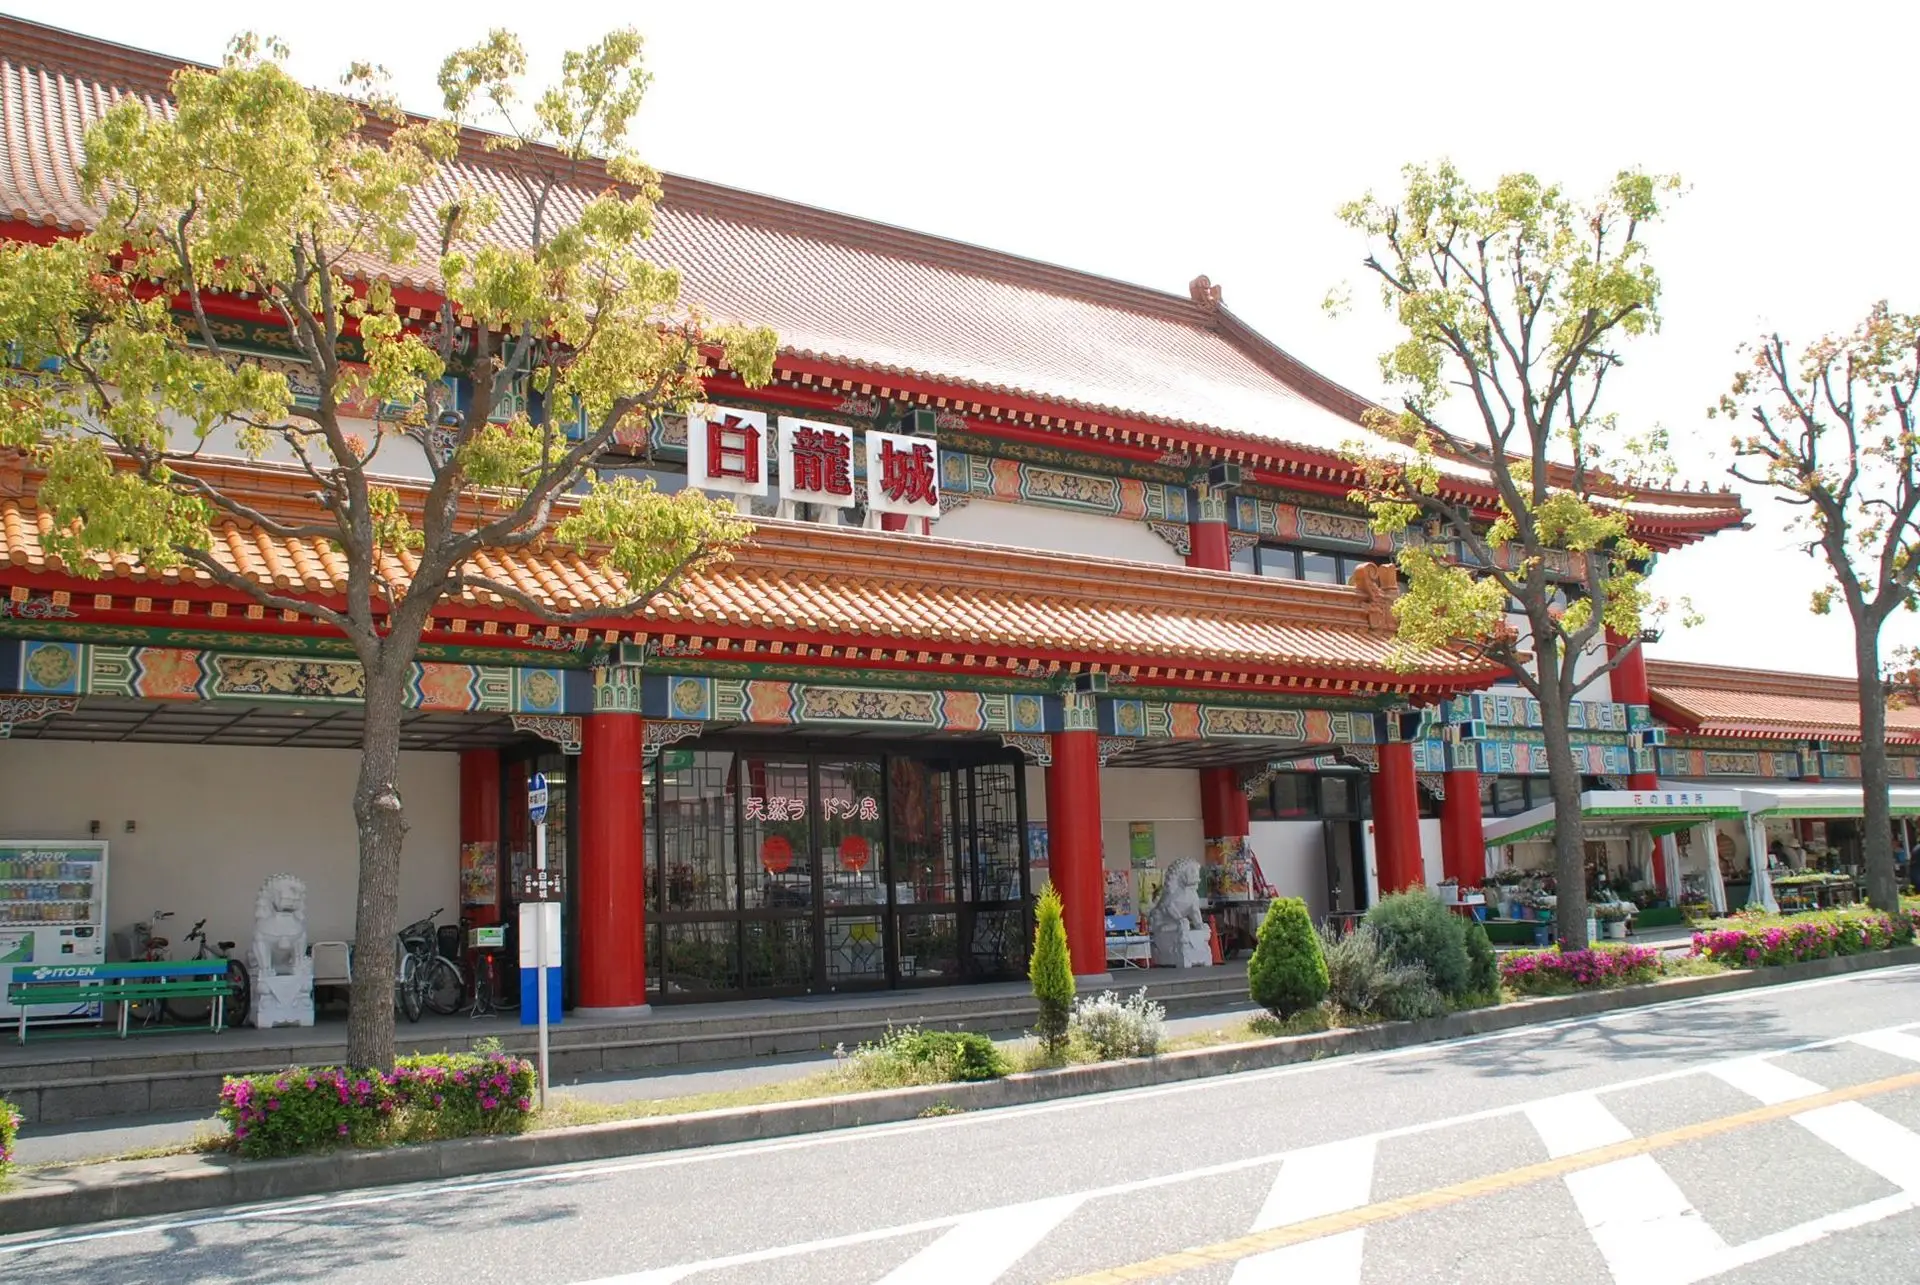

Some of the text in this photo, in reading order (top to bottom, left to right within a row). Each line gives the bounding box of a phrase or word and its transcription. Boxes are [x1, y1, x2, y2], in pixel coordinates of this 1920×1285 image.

[706, 414, 938, 507] 白龍城
[745, 797, 879, 821] 天然ラドン泉
[52, 966, 96, 977] ITO EN
